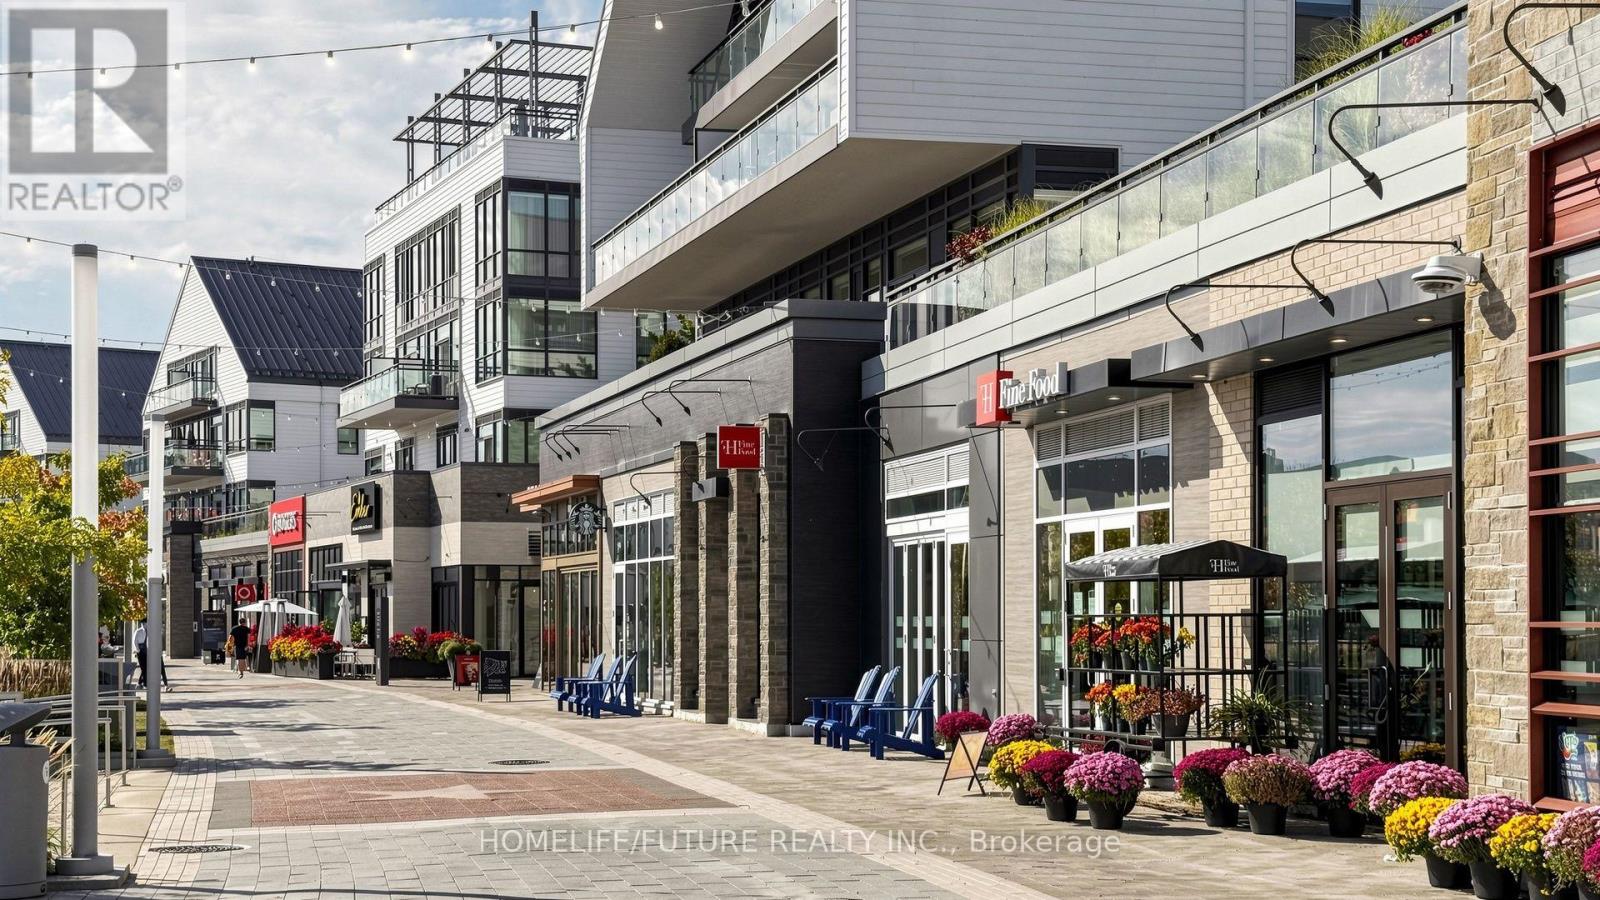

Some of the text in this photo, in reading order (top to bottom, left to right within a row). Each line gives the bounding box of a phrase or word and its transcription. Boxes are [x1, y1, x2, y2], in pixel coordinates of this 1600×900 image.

[998, 362, 1061, 409] Fine Food
[738, 440, 755, 448] Fine
